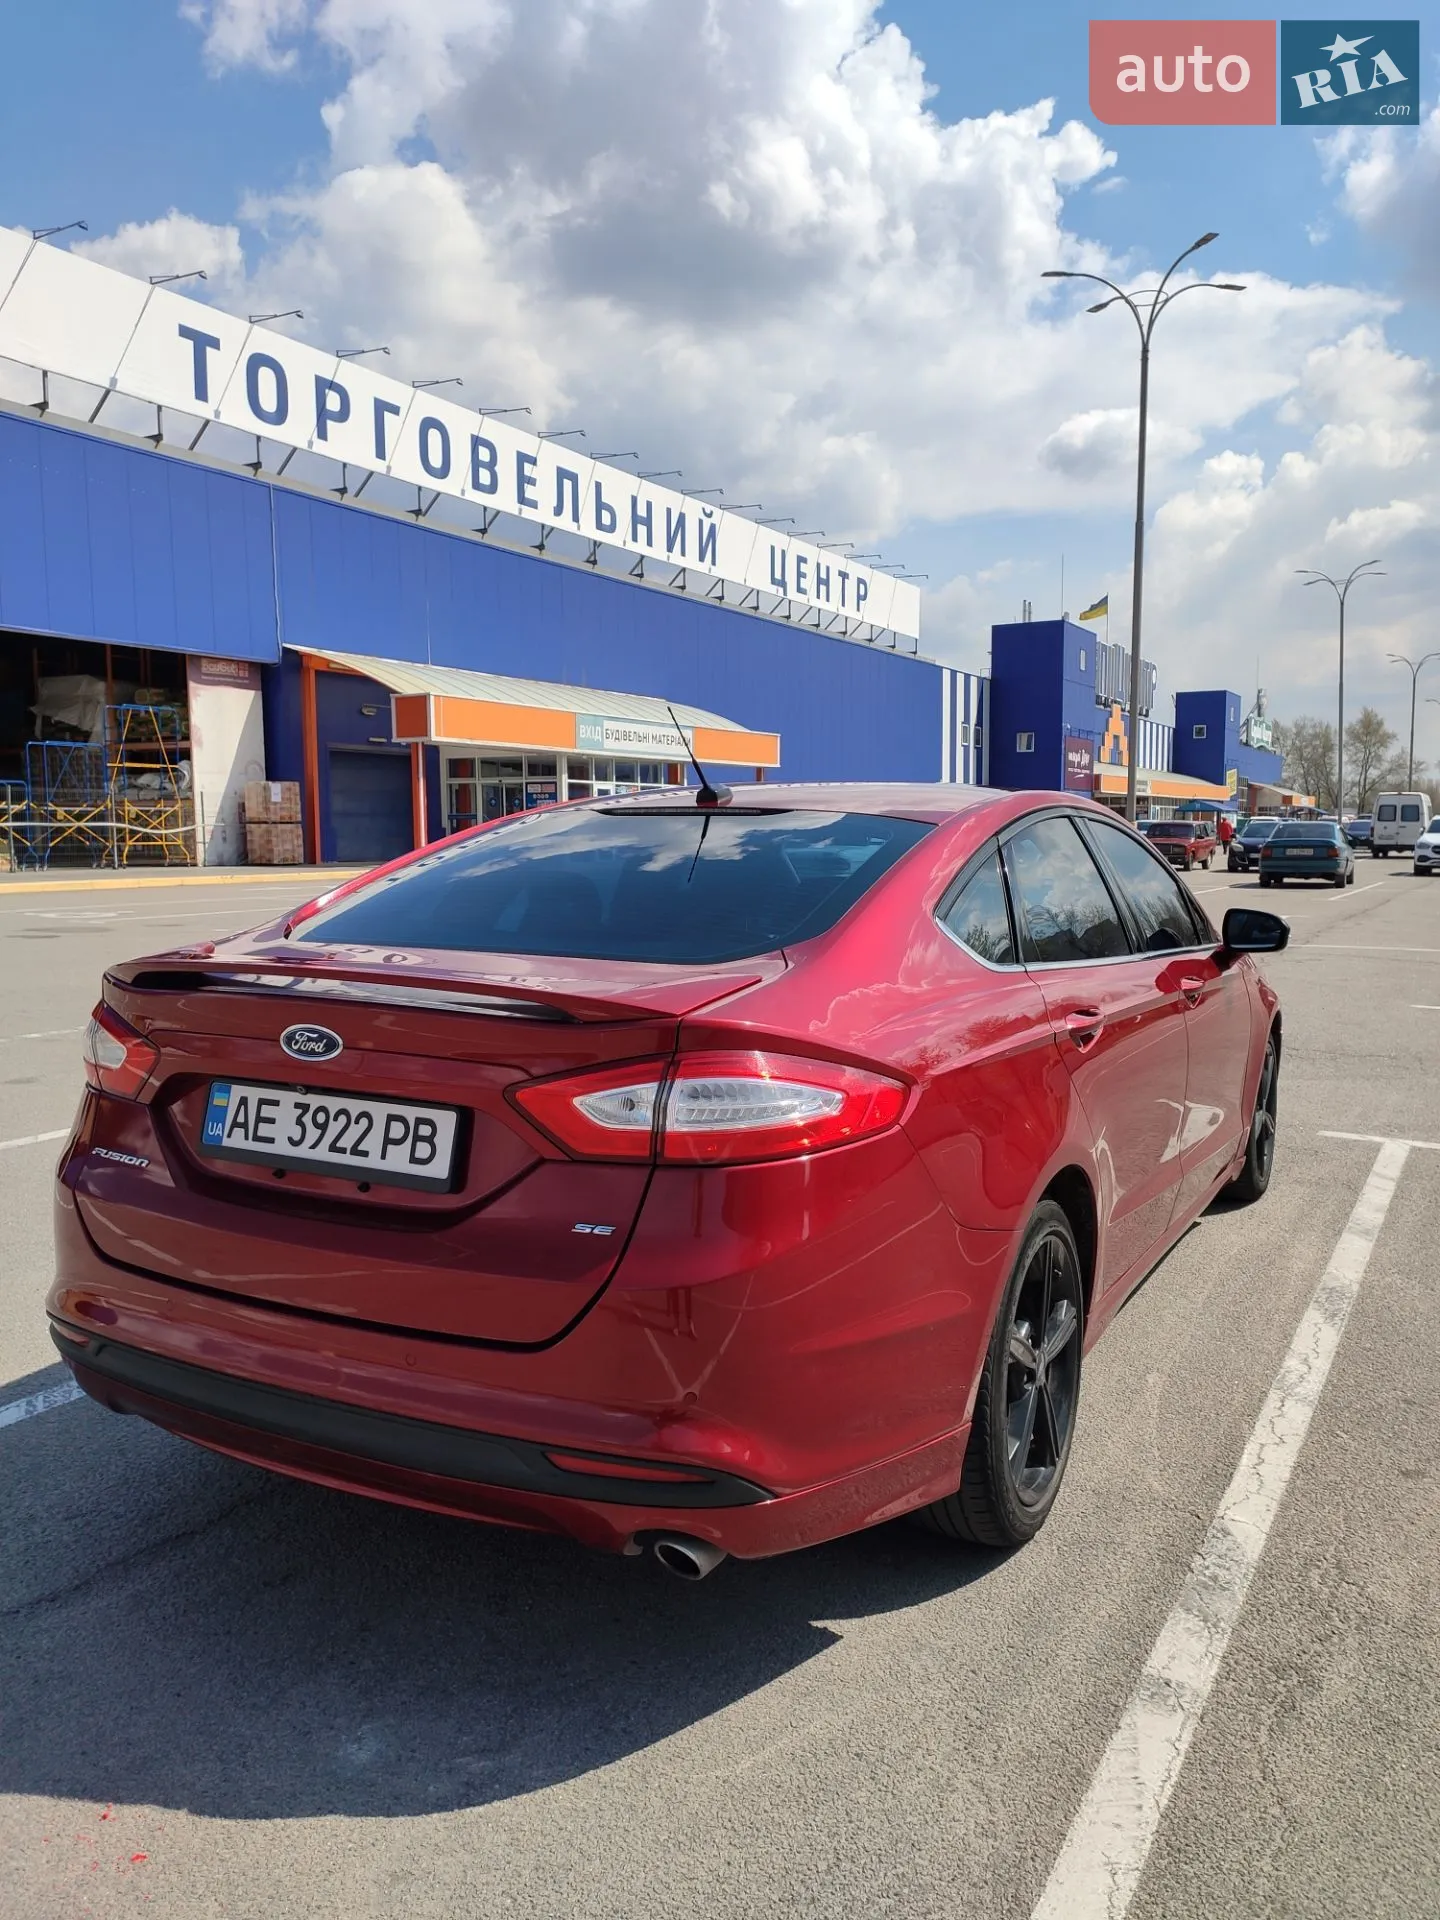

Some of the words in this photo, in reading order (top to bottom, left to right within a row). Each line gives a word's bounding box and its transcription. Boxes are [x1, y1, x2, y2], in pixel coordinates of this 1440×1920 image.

[178, 323, 717, 566] ТОРГОВЕЛЬНИЙ
[770, 544, 868, 612] ЦЕНТР
[579, 724, 602, 742] ВХІД
[605, 728, 650, 743] БУДІВЕЛЬНІ
[291, 1031, 327, 1053] Ford
[207, 1121, 223, 1137] UA
[226, 1096, 280, 1144] AE
[287, 1101, 374, 1158] 3922
[380, 1113, 438, 1165] PB
[92, 1147, 149, 1167] FUSION
[571, 1223, 617, 1235] SE
